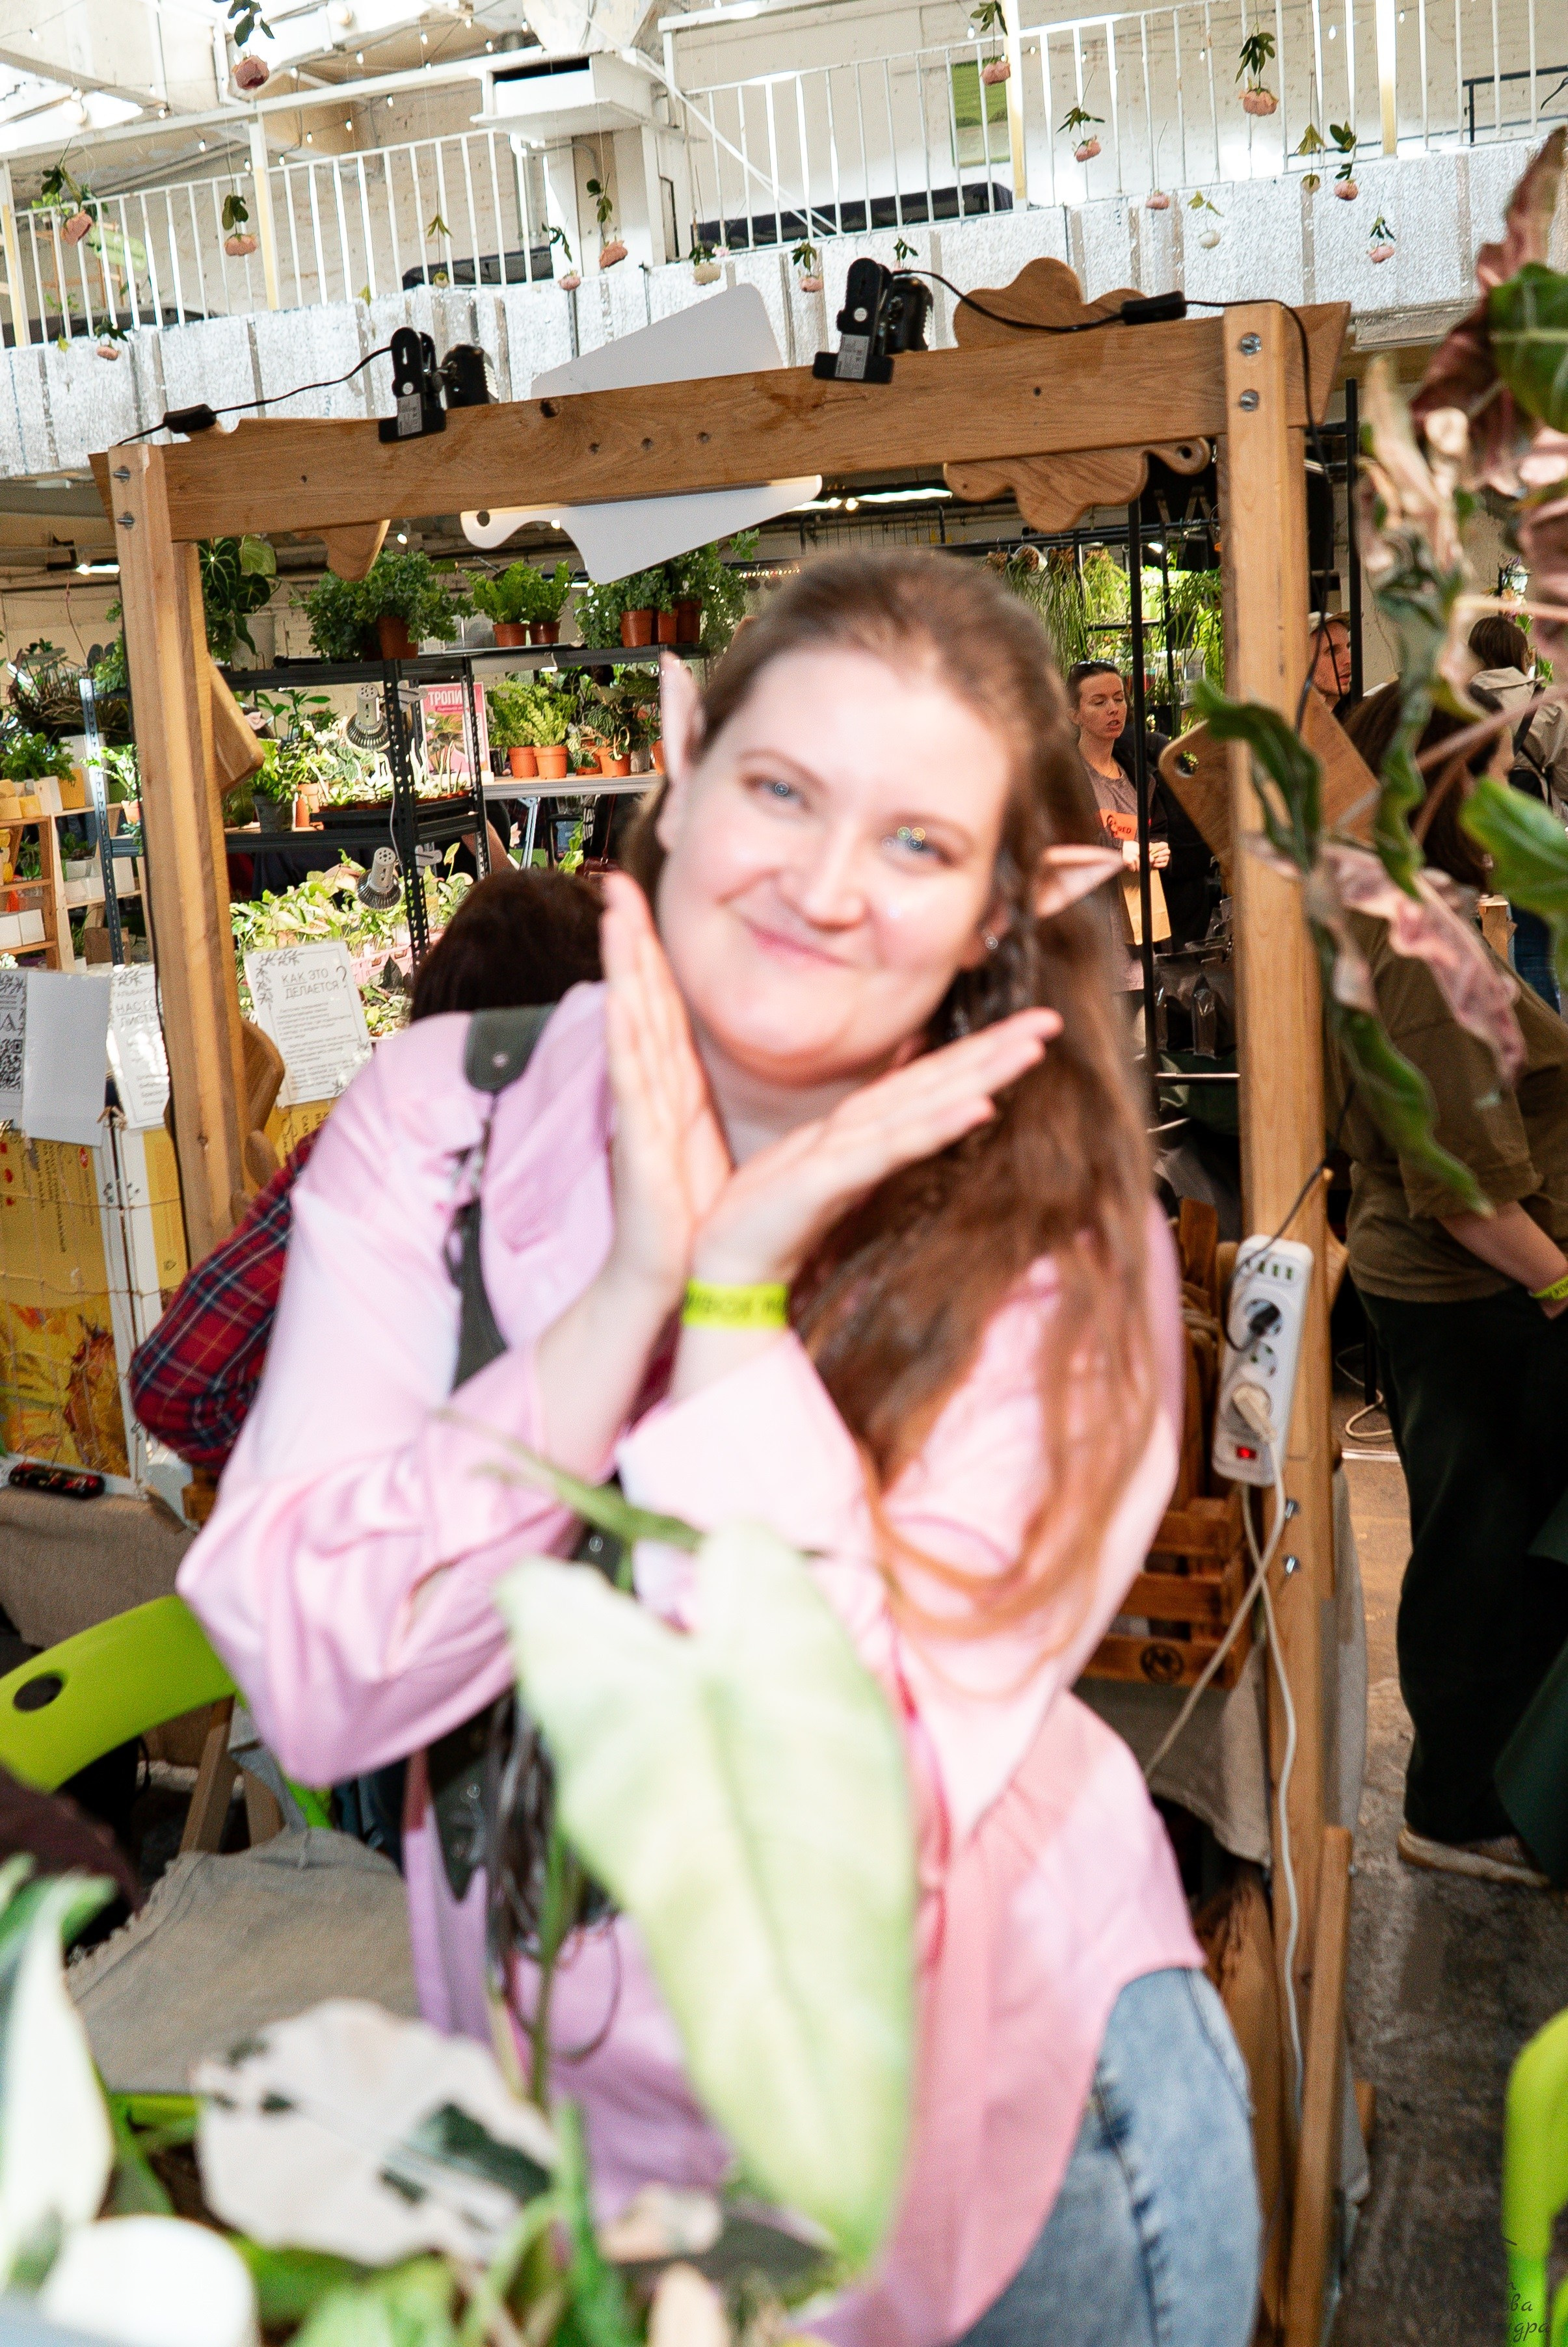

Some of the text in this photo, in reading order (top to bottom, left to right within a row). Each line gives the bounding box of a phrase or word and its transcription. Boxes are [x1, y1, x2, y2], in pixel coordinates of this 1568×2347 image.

[282, 968, 328, 983] КАК ЭТО
[285, 981, 339, 999] ДЕЛАЕТСЯ
